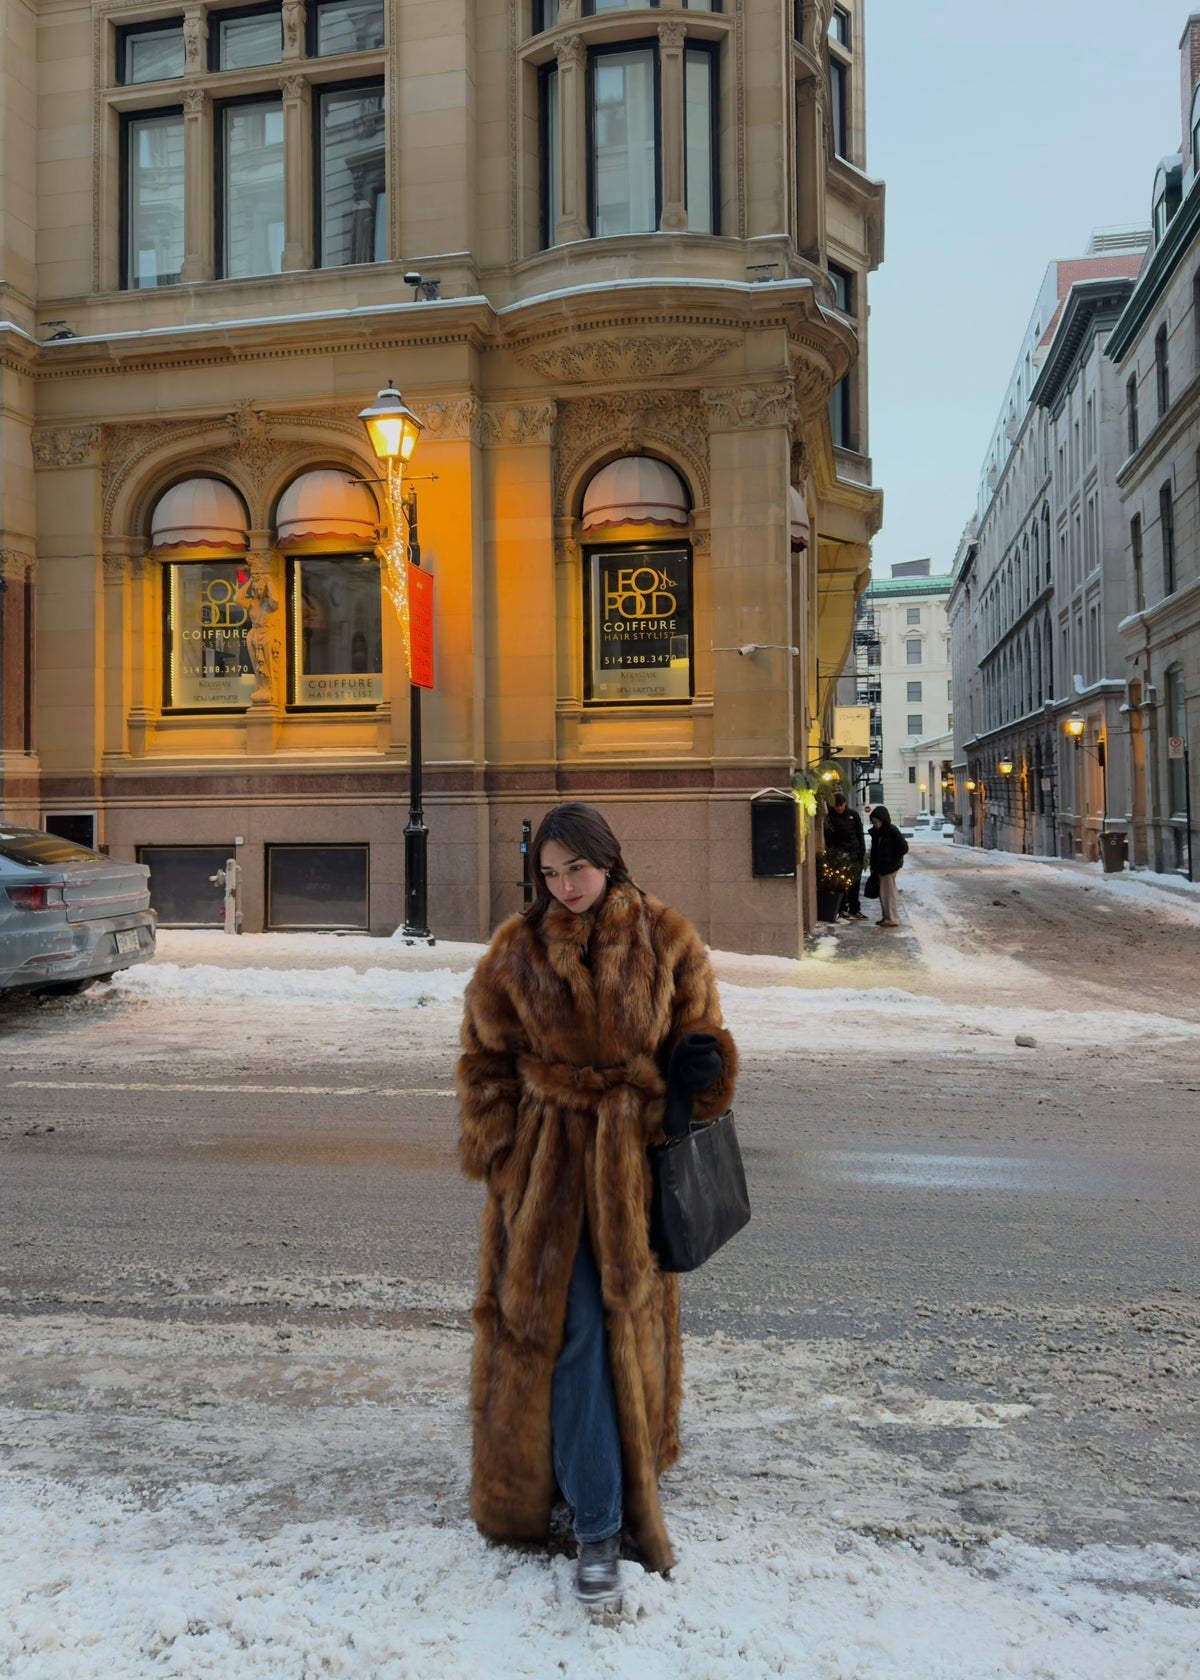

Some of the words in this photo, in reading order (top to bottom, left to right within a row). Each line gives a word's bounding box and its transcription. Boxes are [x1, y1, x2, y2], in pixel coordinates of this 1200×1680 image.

[603, 620, 677, 632] COIFFURE
[182, 629, 248, 640] COIFFURE
[604, 633, 630, 641] HAIR
[633, 631, 676, 640] STYLIST
[604, 655, 623, 664] 514
[626, 654, 677, 664] 288.3470
[183, 666, 200, 674] 514
[203, 664, 249, 674] 288.3470
[308, 678, 373, 689] COIFFURE
[309, 691, 332, 699] HAIR
[335, 689, 373, 698] STYLIST
